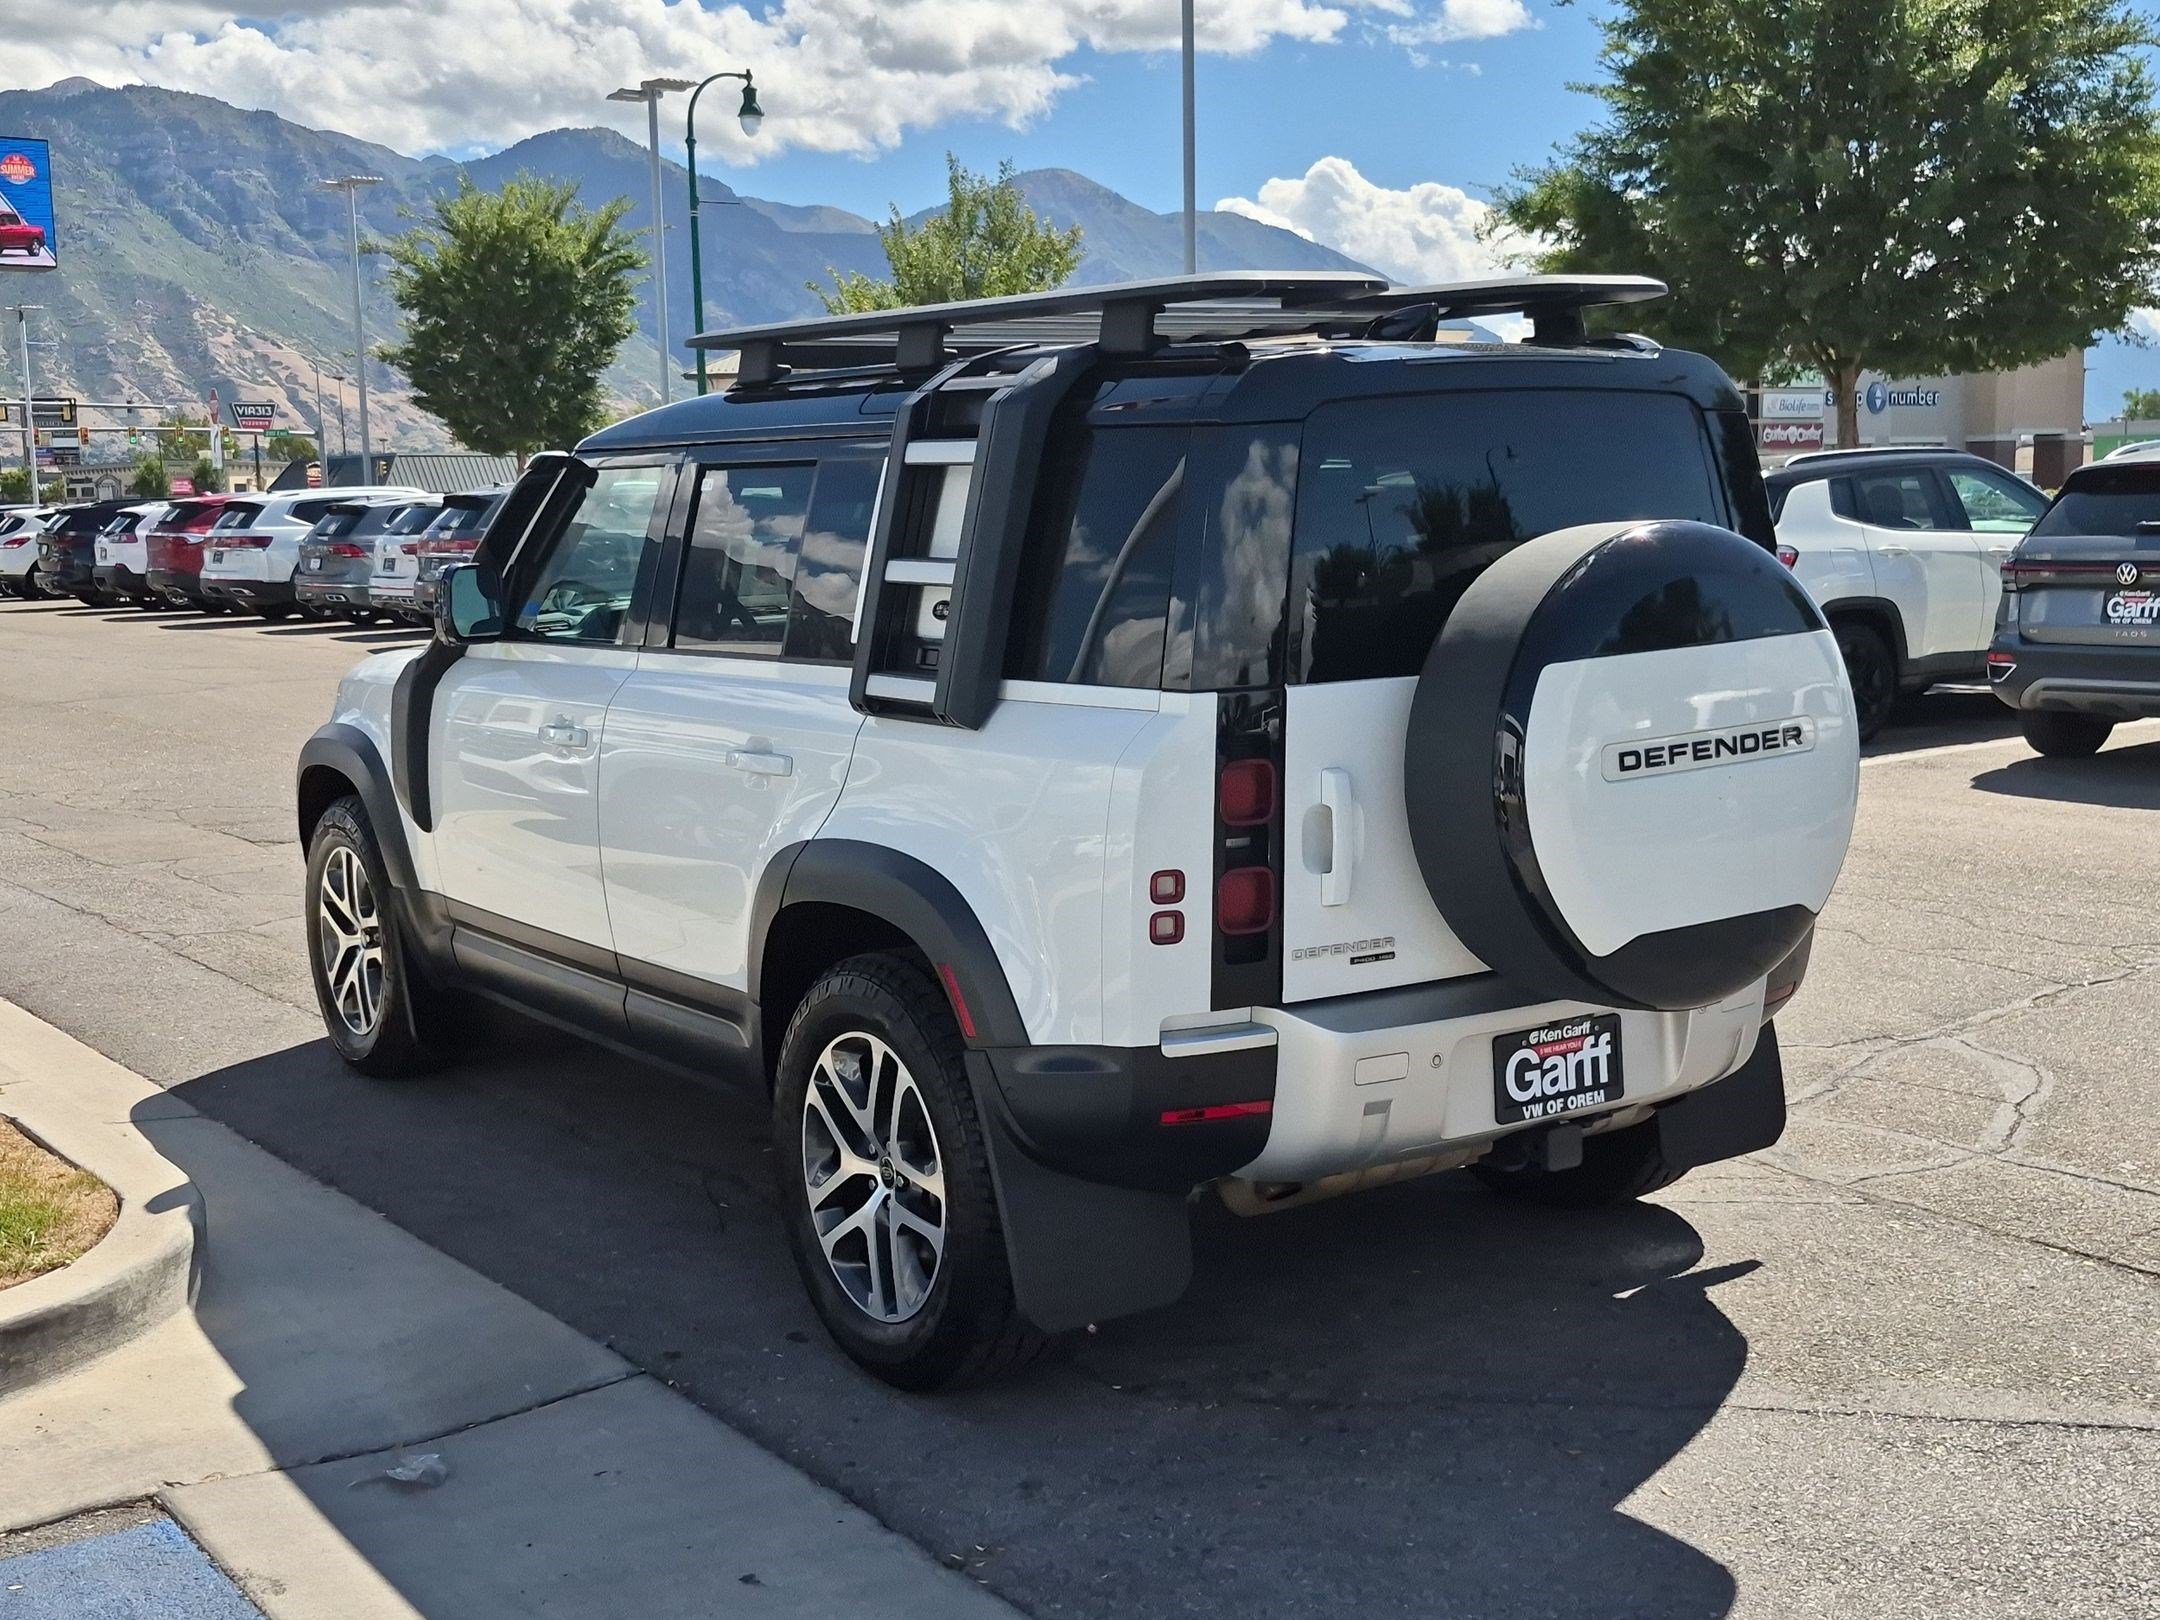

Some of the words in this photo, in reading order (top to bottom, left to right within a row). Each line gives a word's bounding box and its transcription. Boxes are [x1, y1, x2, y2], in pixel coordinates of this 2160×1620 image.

[0, 164, 35, 176] SUMMER
[1778, 399, 1807, 414] BioLife
[1889, 385, 1940, 406] number
[2107, 596, 2160, 618] Garff
[1618, 726, 1803, 772] DEFENDER
[1291, 936, 1396, 961] DEFENDER
[1540, 1028, 1562, 1044] Ken
[1563, 1021, 1591, 1039] Garff
[1553, 1043, 1567, 1052] HEAR
[1567, 1041, 1577, 1049] YOU
[1505, 1032, 1611, 1102] Garff
[1522, 1102, 1543, 1119] VW
[1546, 1098, 1564, 1114] OF
[1567, 1089, 1605, 1110] OREM
